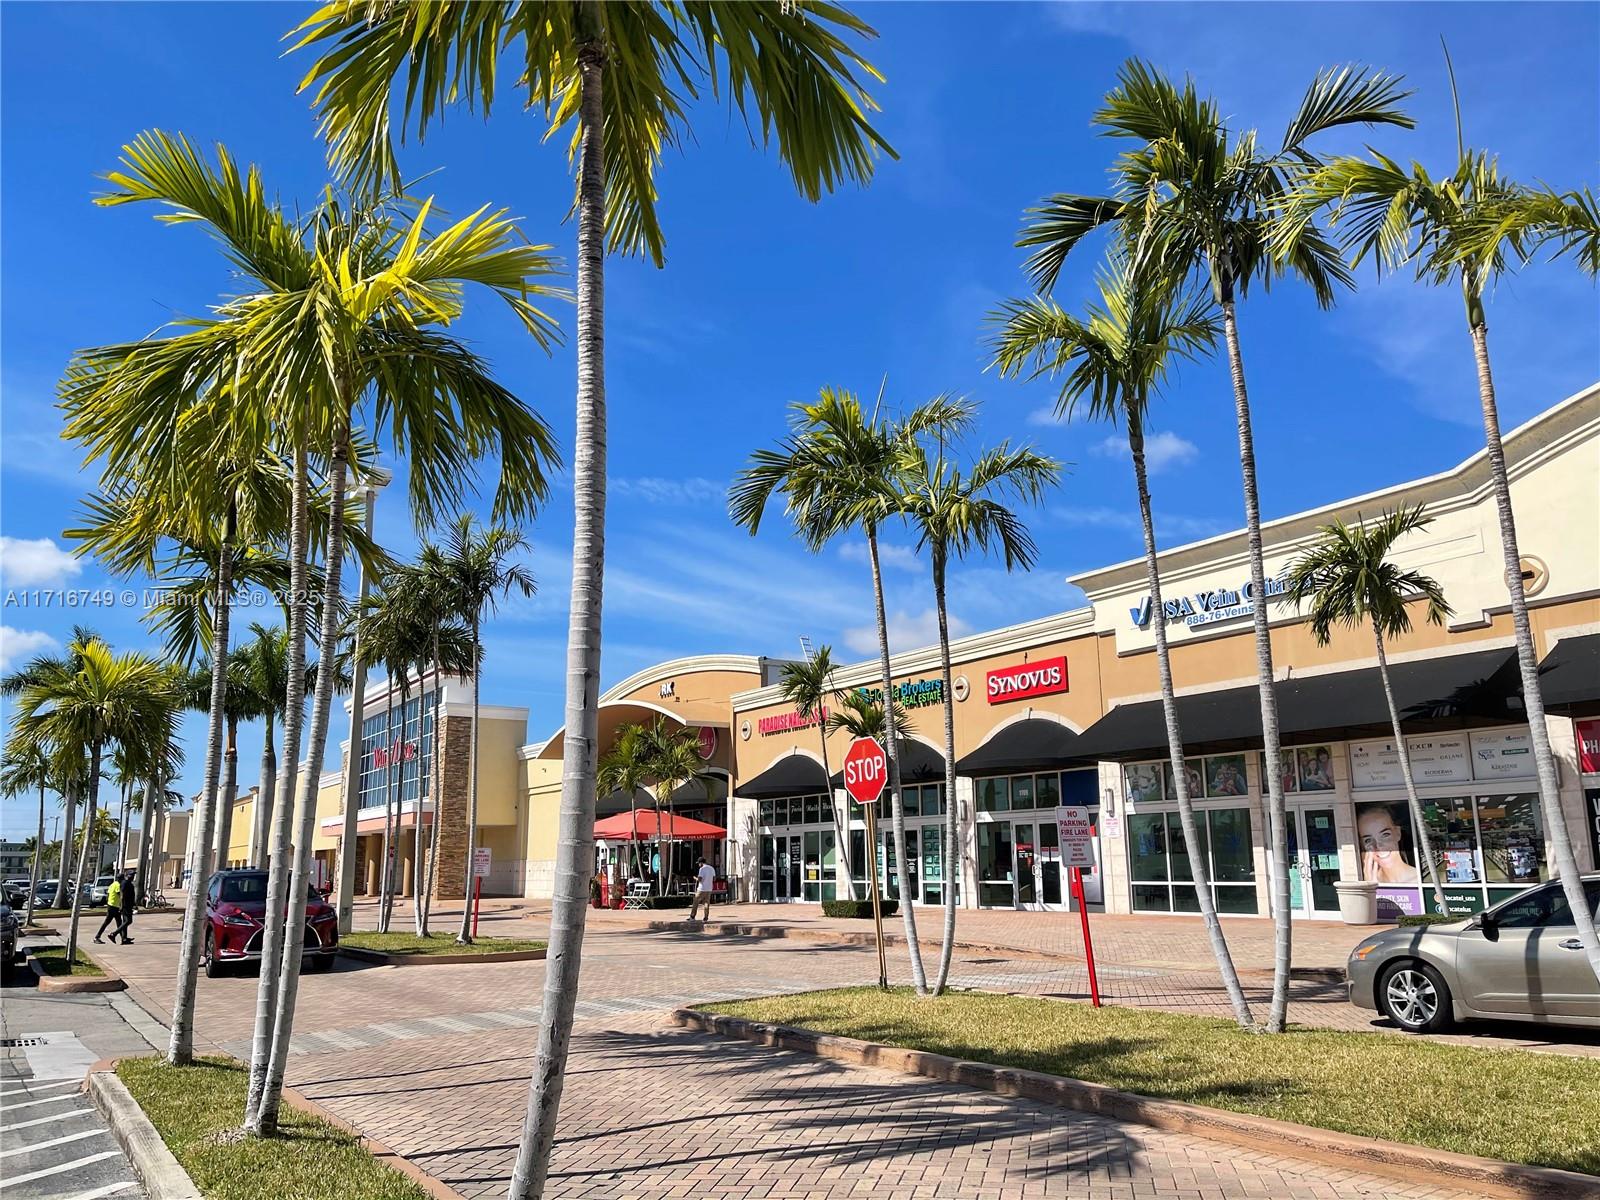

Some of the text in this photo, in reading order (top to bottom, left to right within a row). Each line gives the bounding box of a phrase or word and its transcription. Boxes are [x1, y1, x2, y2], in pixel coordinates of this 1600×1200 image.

[1195, 589, 1237, 611] Vein
[661, 682, 673, 696] RK
[901, 680, 942, 697] Brokers
[988, 666, 1061, 696] SYNOVUS
[902, 691, 941, 706] REAL ESTATE
[758, 713, 788, 734] PARADISE
[847, 755, 883, 784] STOP
[1066, 810, 1078, 818] NO
[1444, 894, 1476, 902] locatel_usa
